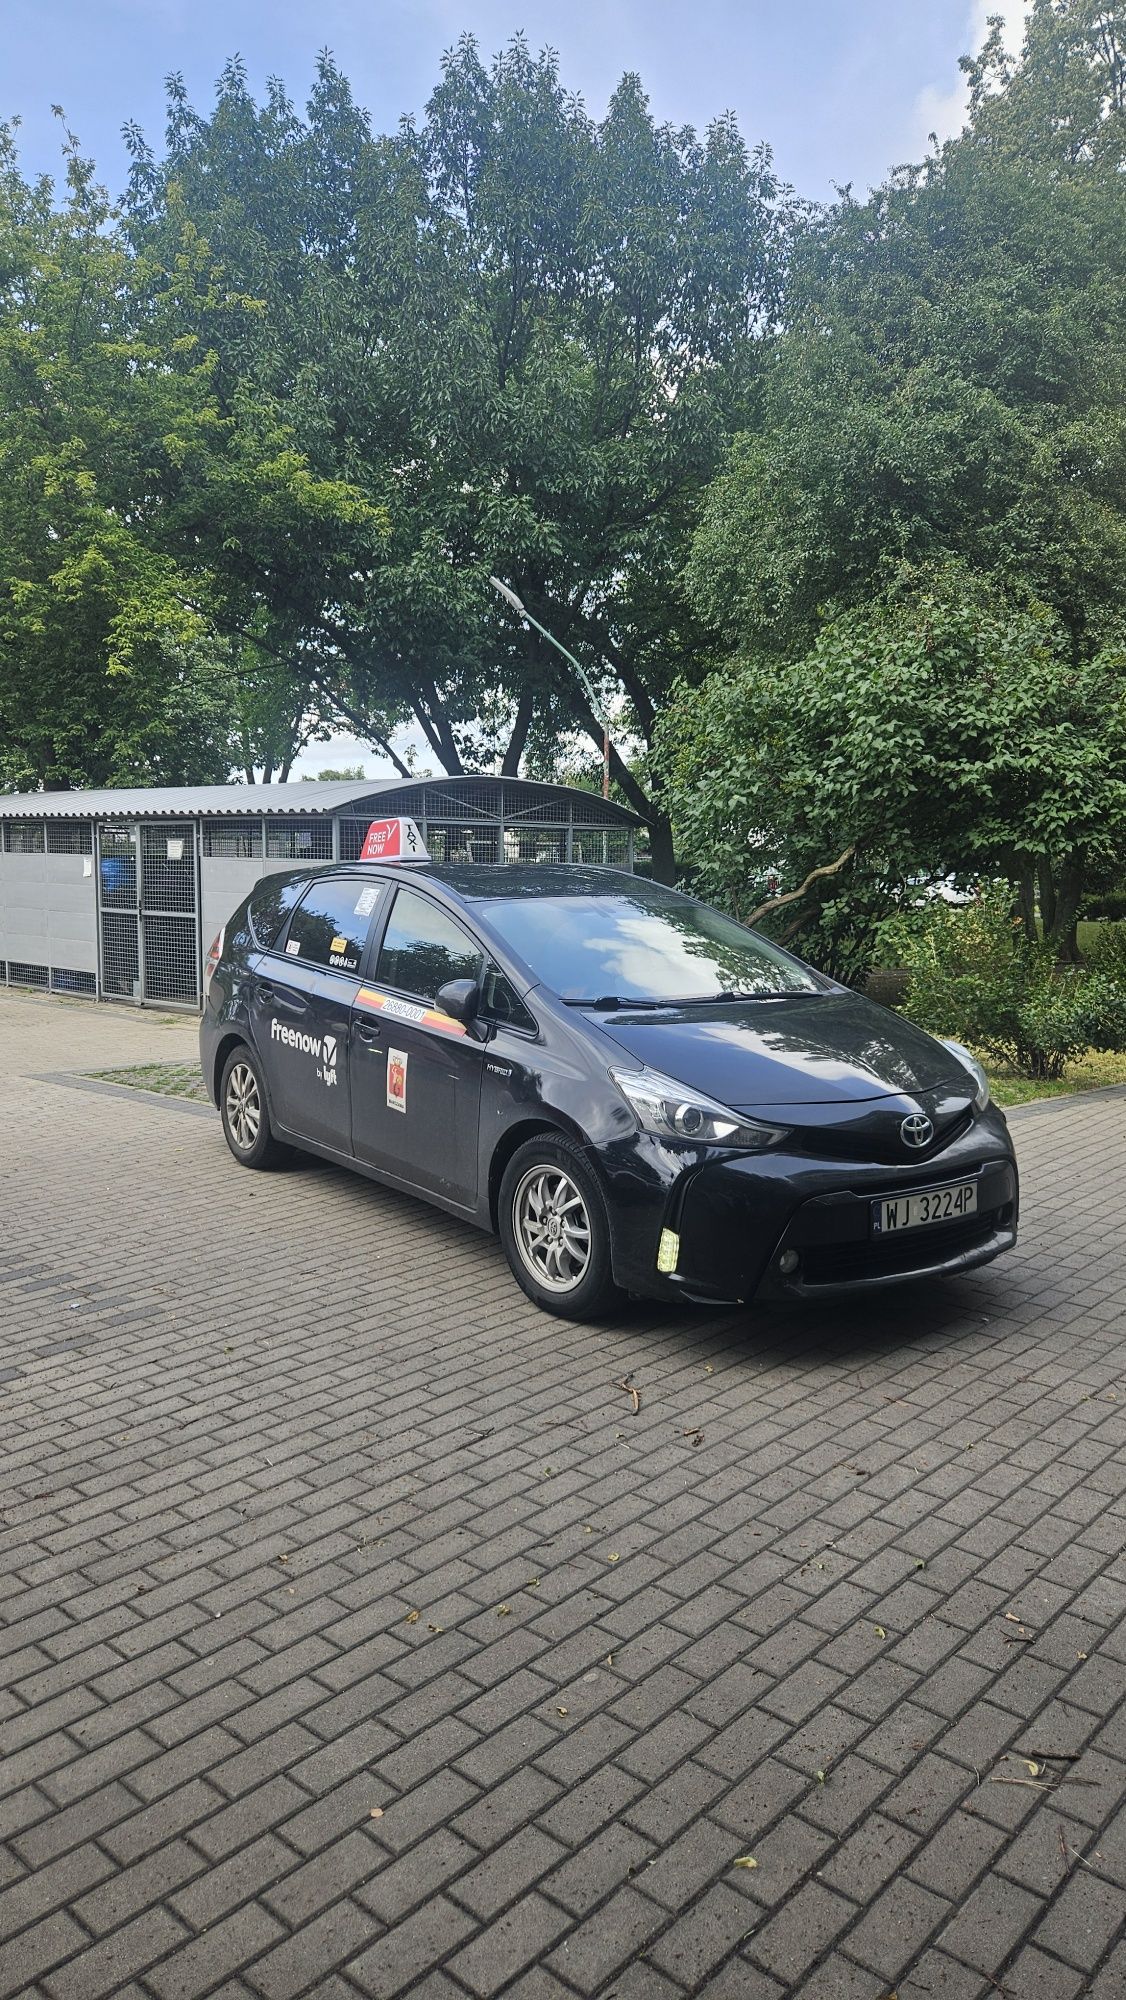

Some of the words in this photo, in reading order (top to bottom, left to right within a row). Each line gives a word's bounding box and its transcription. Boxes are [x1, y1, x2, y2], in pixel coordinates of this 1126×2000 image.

[368, 831, 387, 844] FREE
[404, 823, 419, 852] TAXI
[366, 843, 385, 856] NOW
[271, 1017, 322, 1058] freenow
[323, 1065, 337, 1086] lyft
[886, 1199, 910, 1230] WJ
[919, 1186, 974, 1222] 3224P
[873, 1222, 881, 1230] PL
